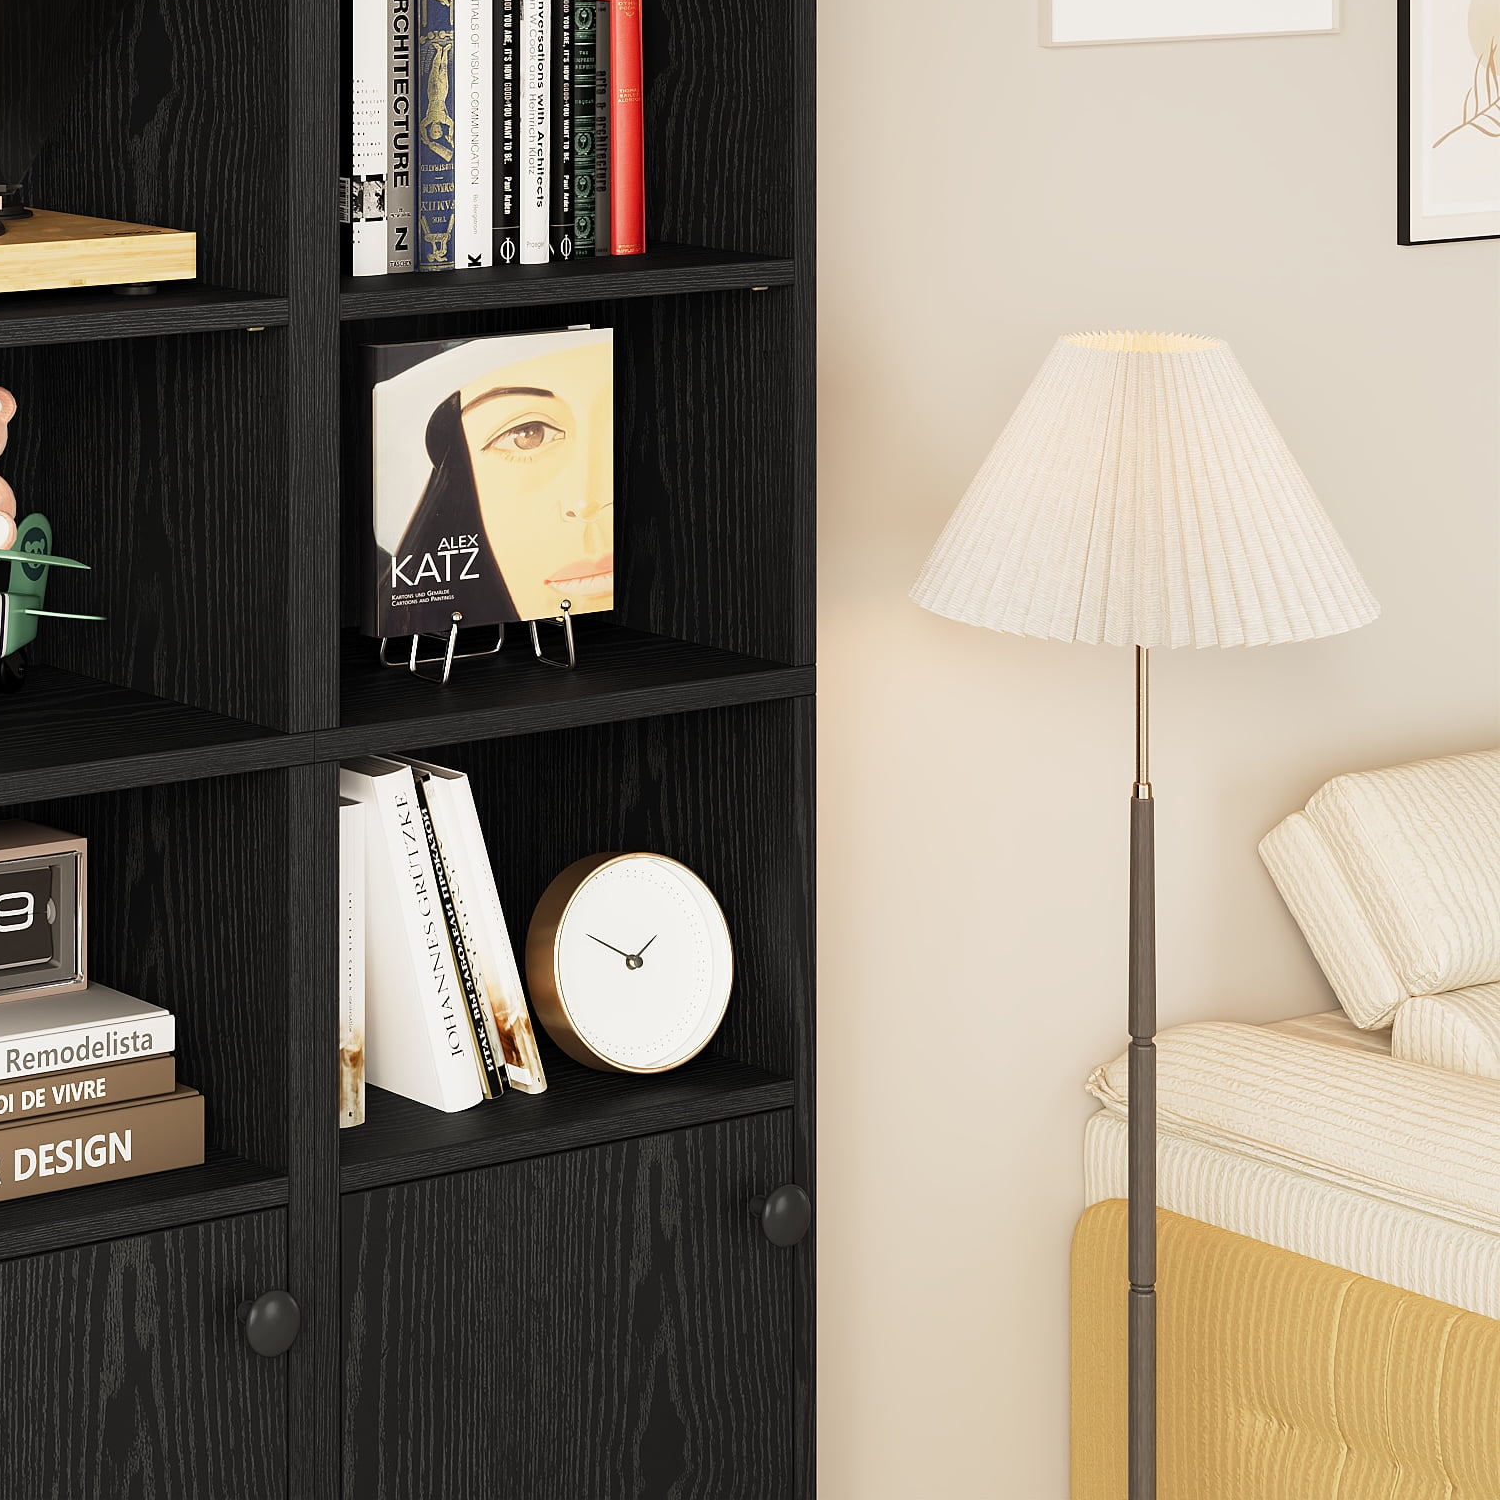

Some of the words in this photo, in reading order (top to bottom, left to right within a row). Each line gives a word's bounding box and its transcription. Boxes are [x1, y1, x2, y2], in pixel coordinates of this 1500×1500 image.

[504, 12, 512, 28] YOU
[470, 33, 480, 48] OF
[504, 48, 512, 62] IT'S
[470, 51, 480, 89] VISUAL
[504, 64, 512, 80] HOW
[529, 65, 537, 90] and
[596, 70, 608, 95] arts
[528, 93, 537, 143] Heinrich
[537, 94, 545, 125] with
[470, 91, 480, 185] COMMUNICATION
[504, 119, 512, 139] WANT
[504, 141, 512, 151] TO
[563, 141, 570, 150] TO
[596, 116, 608, 193] architecture
[528, 147, 536, 175] Klotz
[536, 131, 545, 208] Architects
[504, 176, 512, 192] Paul
[504, 194, 512, 215] Arden
[437, 533, 479, 551] ALEX
[391, 547, 480, 588] KATZ
[394, 791, 431, 917] GRÜTZKE
[424, 921, 464, 1057] JOHANNES
[5, 1030, 154, 1073] Remodelista
[21, 1088, 46, 1111] DE
[51, 1077, 107, 1106] VIVRE
[13, 1129, 133, 1182] DESIGN
